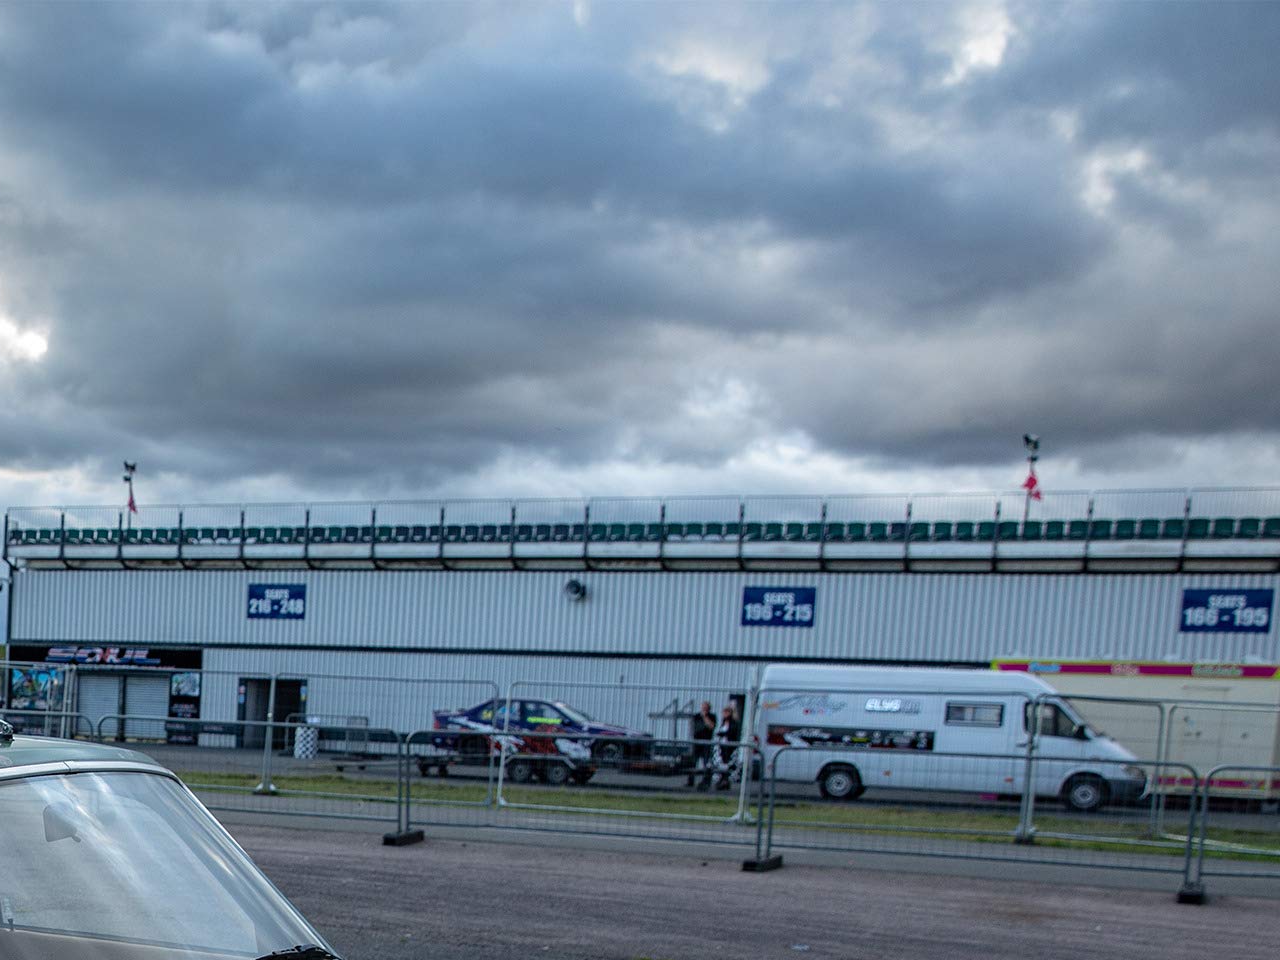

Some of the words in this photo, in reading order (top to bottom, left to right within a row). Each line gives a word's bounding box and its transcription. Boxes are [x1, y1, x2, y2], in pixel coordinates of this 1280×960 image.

[763, 592, 795, 605] SEATS
[1208, 595, 1247, 609] SEATS
[744, 603, 773, 621] 196
[783, 603, 813, 622] 215
[1184, 607, 1220, 626] 166
[1232, 607, 1268, 627] 195
